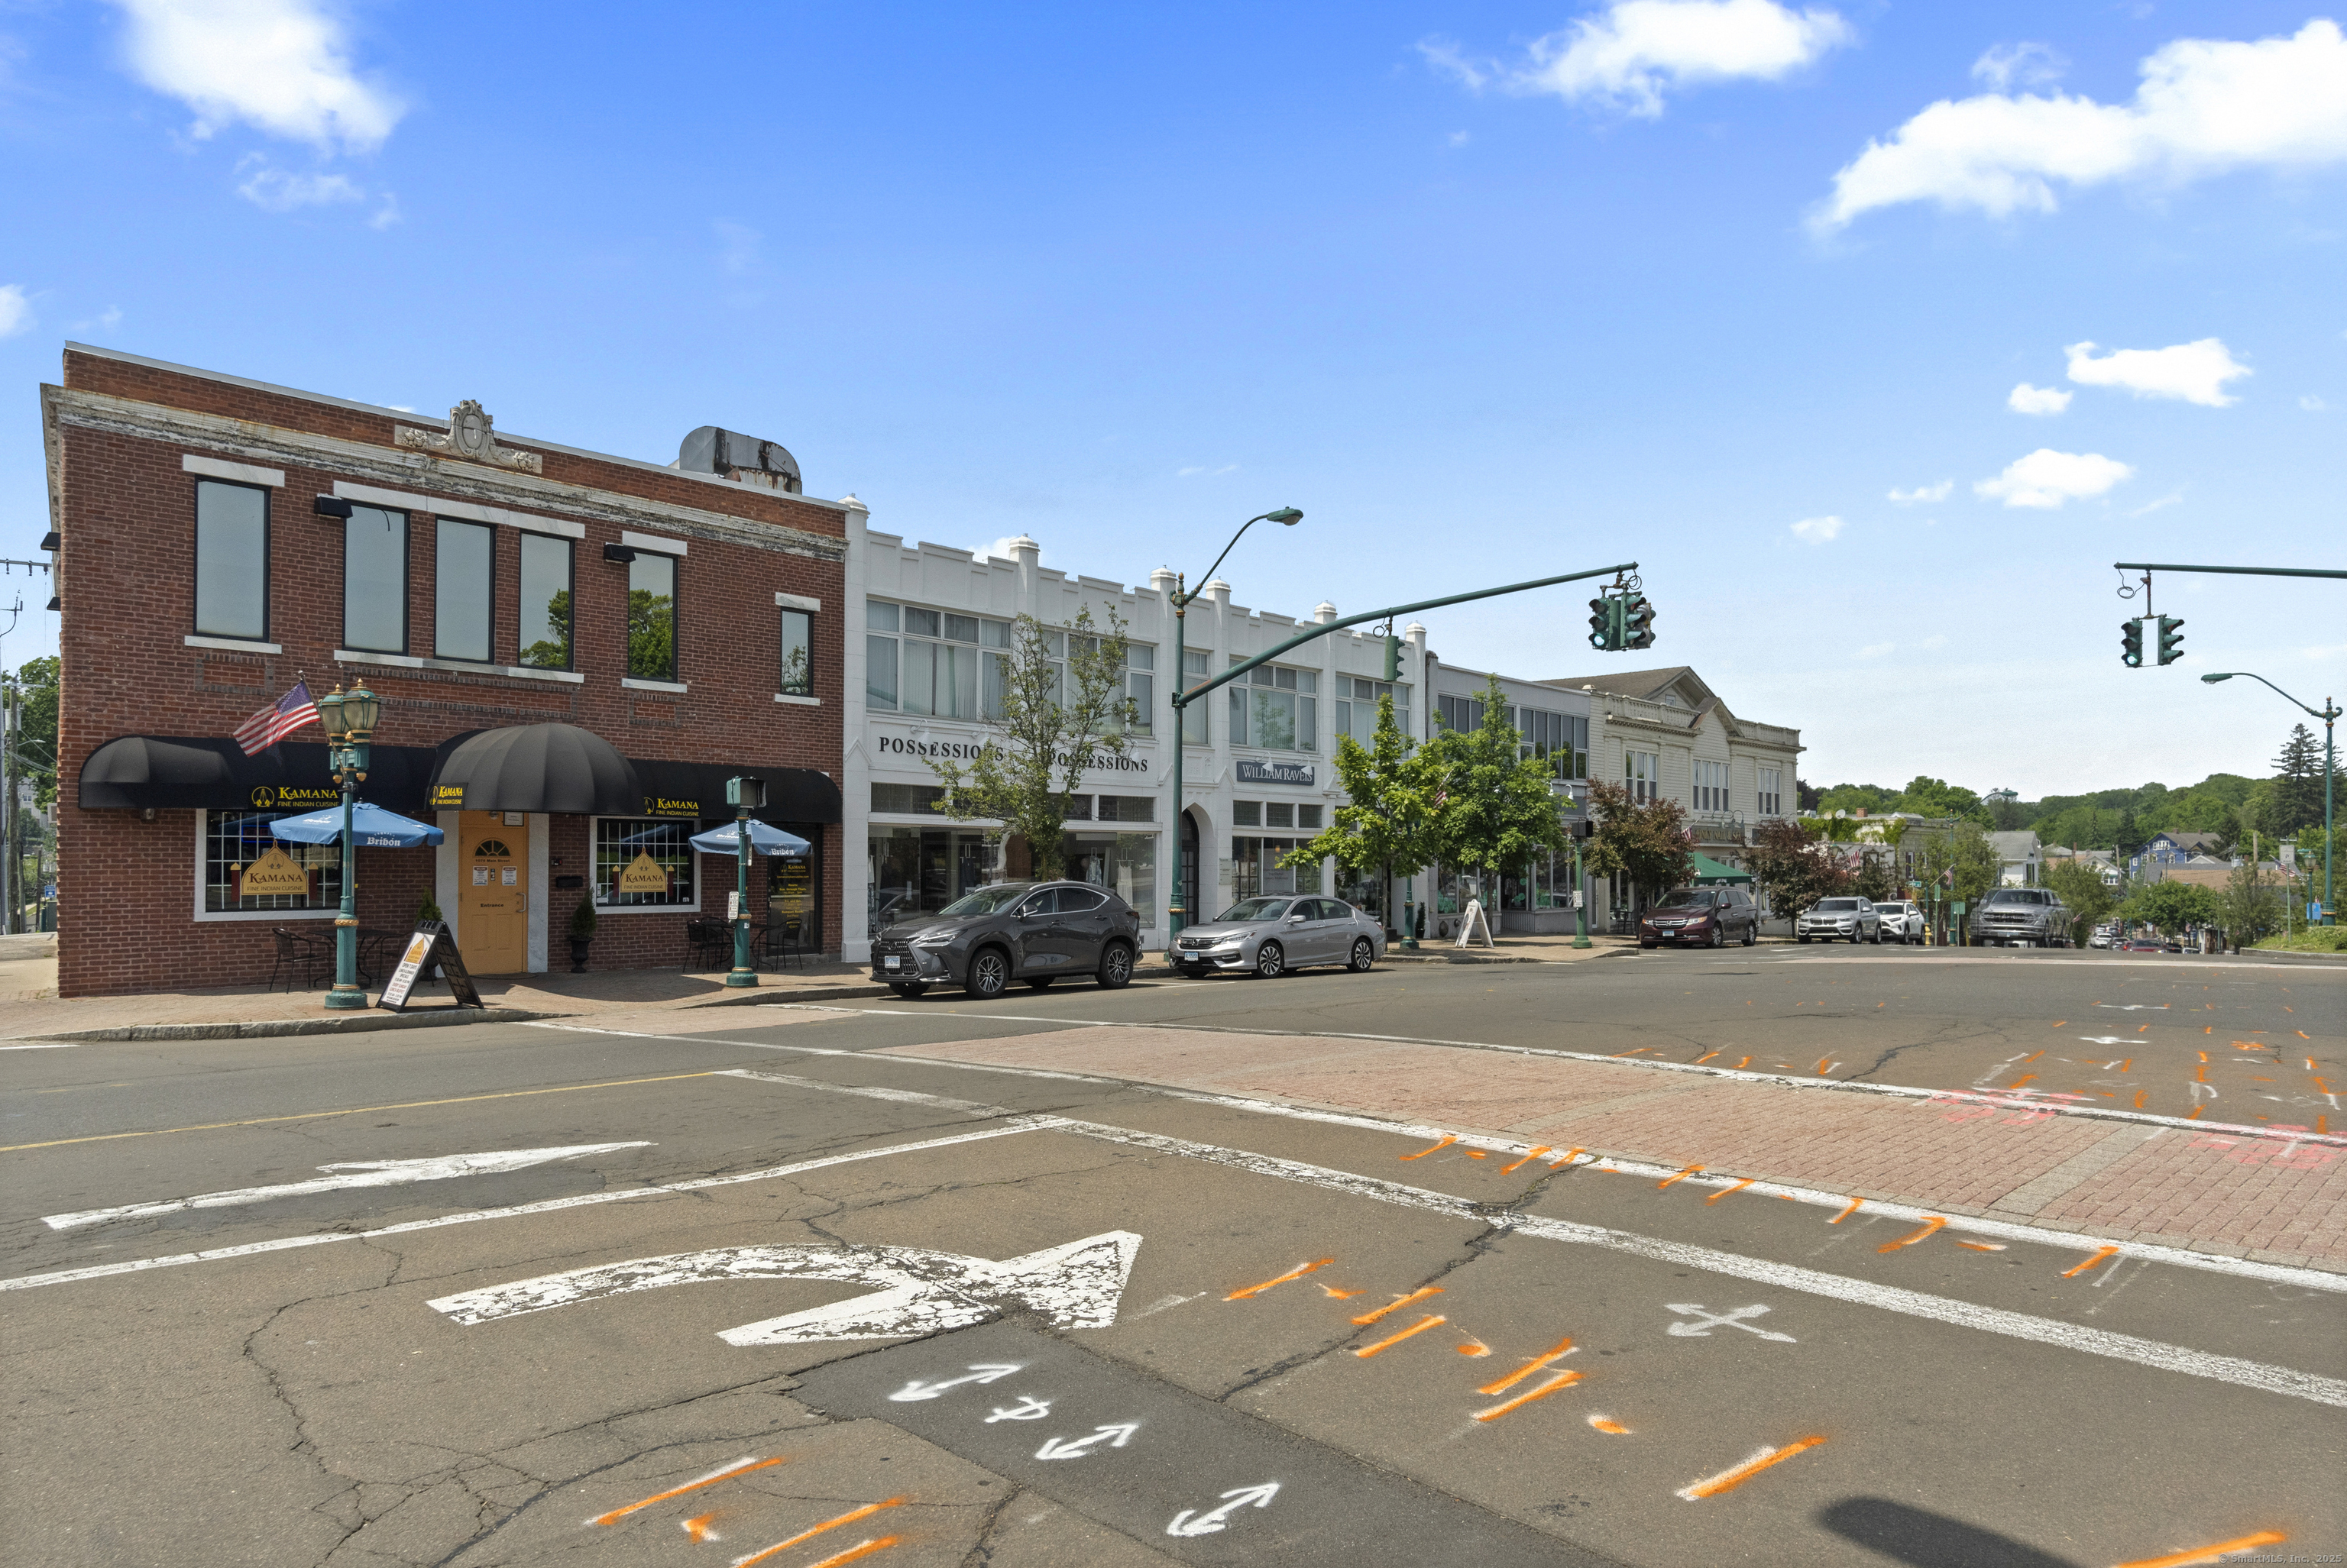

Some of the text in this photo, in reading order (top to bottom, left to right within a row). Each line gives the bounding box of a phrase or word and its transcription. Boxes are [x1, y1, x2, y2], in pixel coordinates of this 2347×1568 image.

[879, 737, 1004, 761] POSSESSIOS
[1050, 752, 1148, 771] POESSIONS
[1242, 765, 1313, 782] WILLIAM RAVEIS
[278, 787, 338, 800] KAMANA
[439, 786, 462, 797] KAMANA
[657, 798, 699, 810] KAMANA
[366, 836, 401, 847] Bribón
[248, 872, 303, 884] KAMANA
[625, 874, 663, 884] KAMANA
